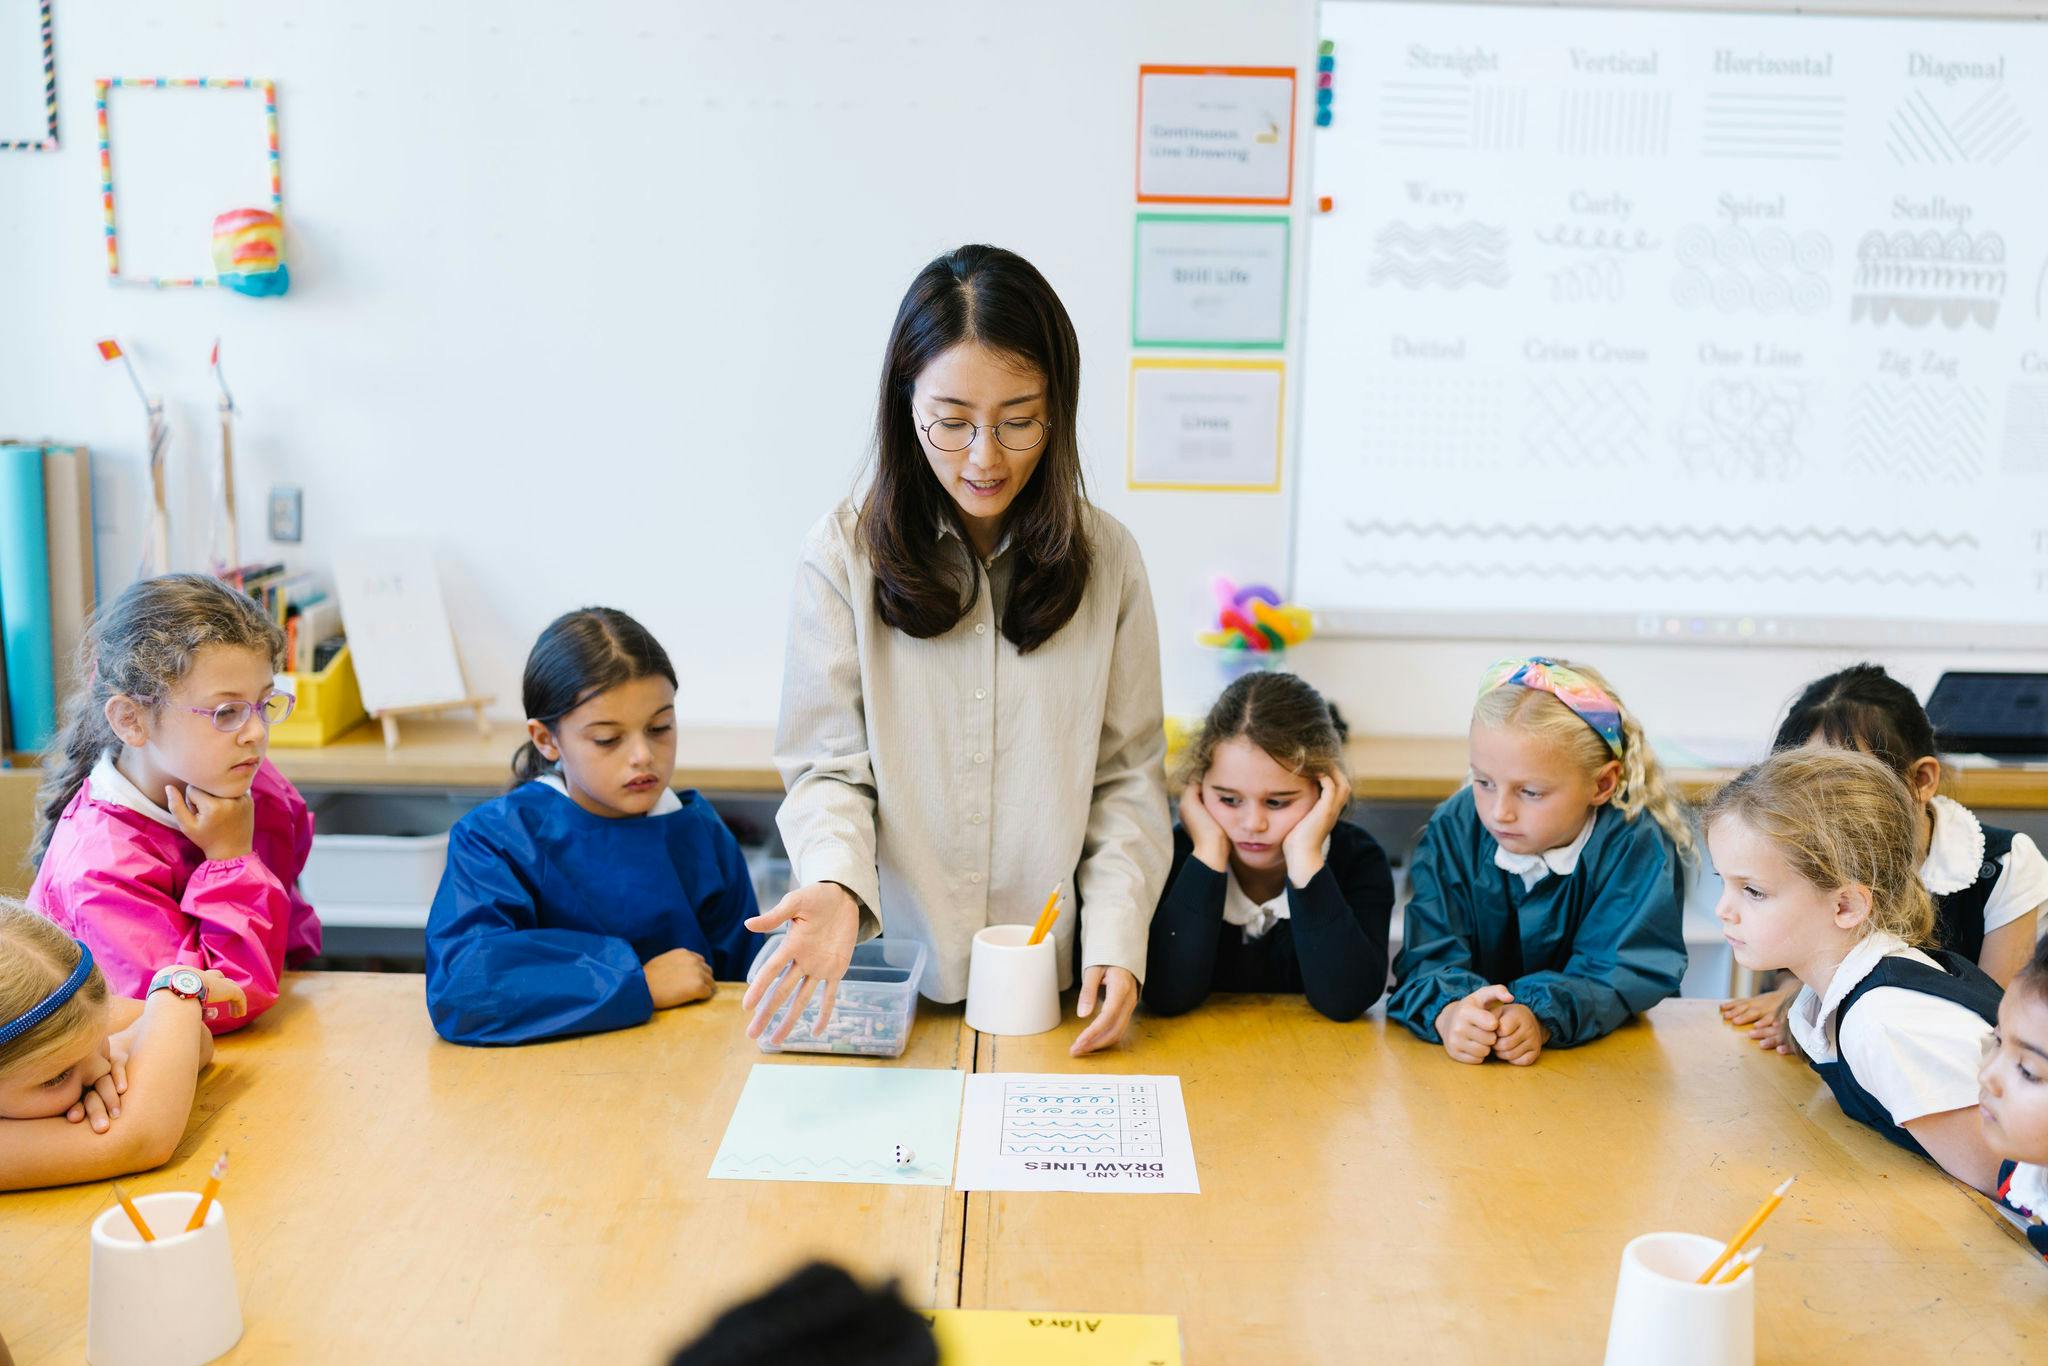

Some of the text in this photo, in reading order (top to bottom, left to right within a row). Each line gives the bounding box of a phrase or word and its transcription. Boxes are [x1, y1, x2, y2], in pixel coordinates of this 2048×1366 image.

[1407, 43, 1499, 77] Straight
[1568, 45, 1660, 76] Vertical
[1713, 47, 1834, 78] Horizontal
[1905, 52, 2006, 84] Diagonal
[1407, 180, 1467, 212] Wavy
[1569, 190, 1633, 218] Curly
[1716, 192, 1787, 225] Spiral
[1891, 194, 1974, 226] Scallop
[1697, 341, 1804, 369] One Line
[1879, 348, 1960, 378] Zig Zag
[1024, 1161, 1164, 1172] DRAW LINES
[1086, 1171, 1165, 1179] ROLL AND
